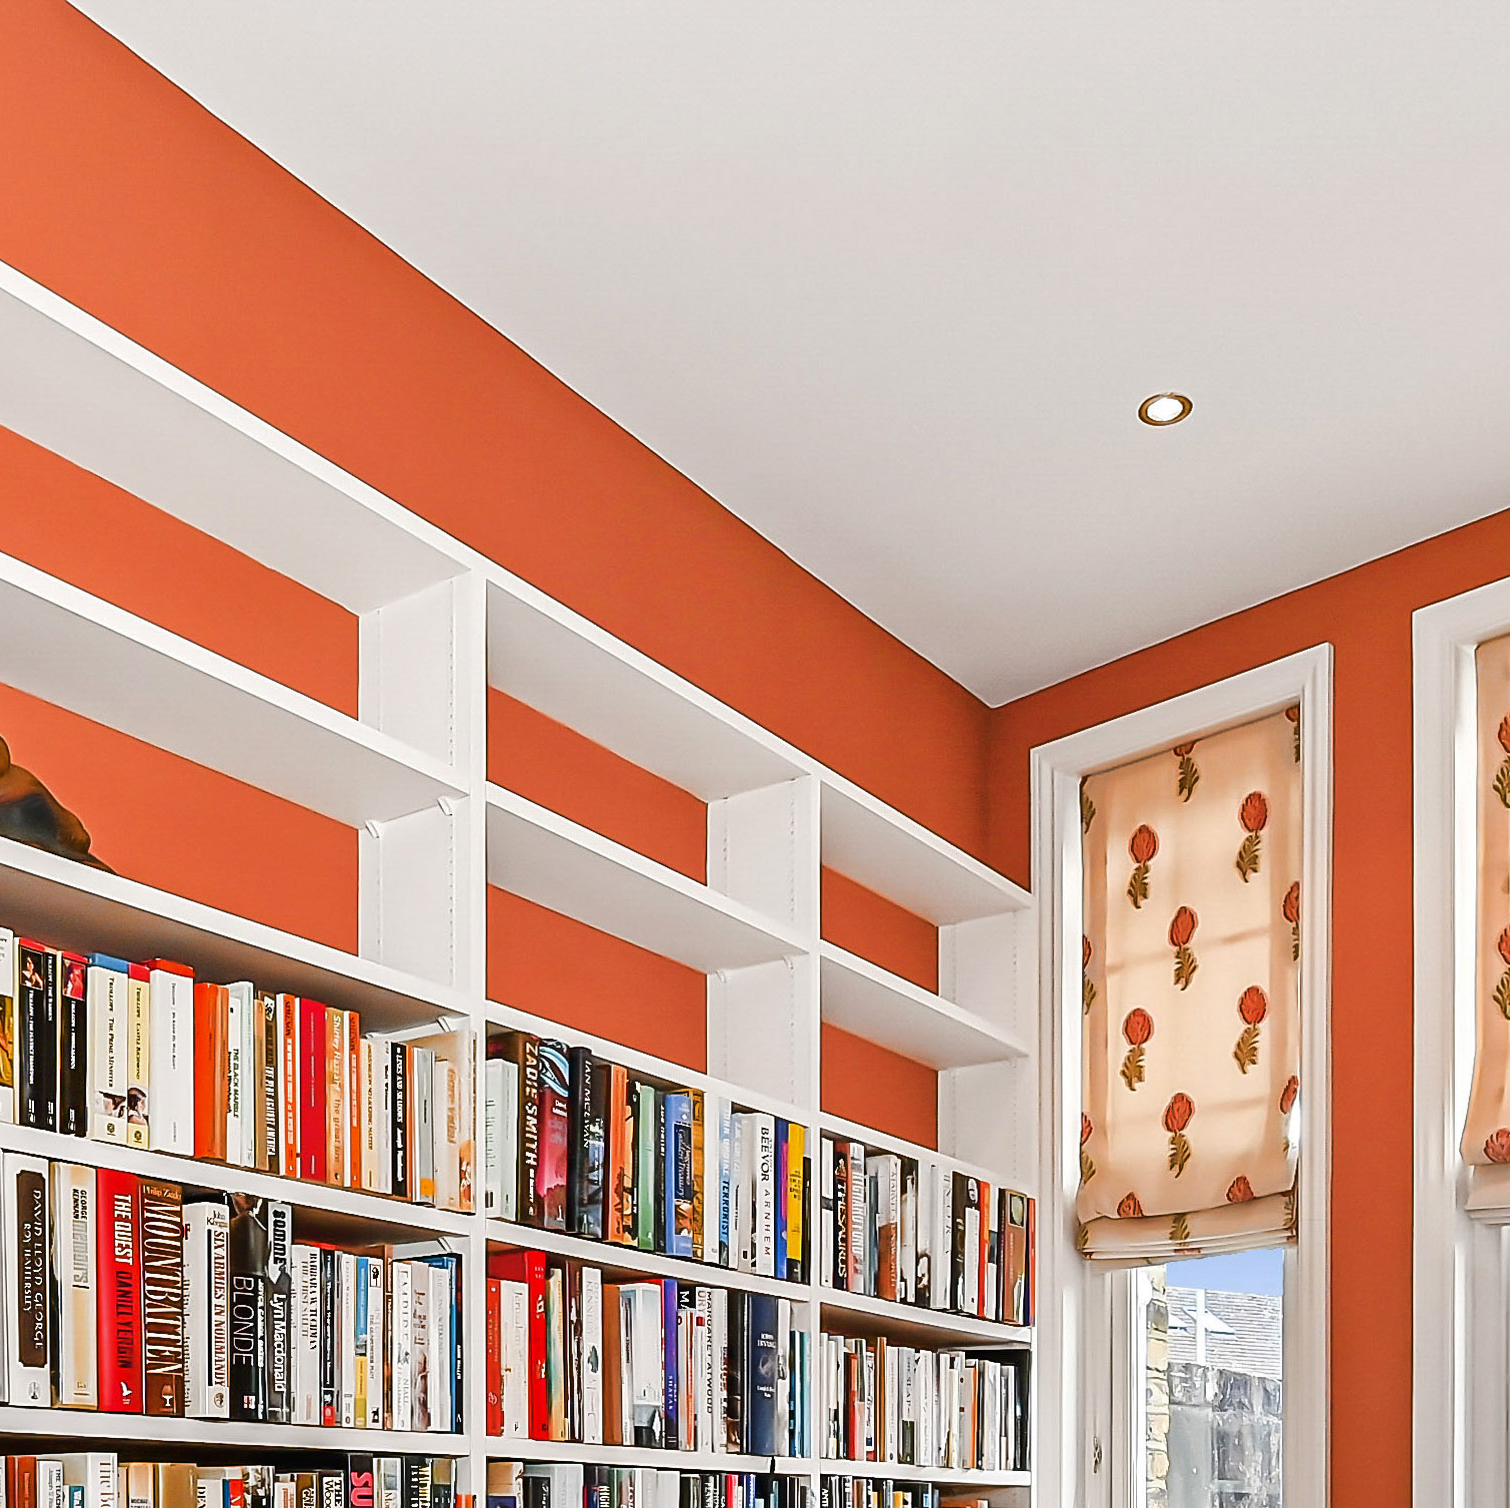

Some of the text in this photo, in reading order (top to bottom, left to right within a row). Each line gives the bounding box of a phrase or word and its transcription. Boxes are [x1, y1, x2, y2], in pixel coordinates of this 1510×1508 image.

[524, 1104, 537, 1164] SMITH
[114, 1194, 133, 1267] THE QUEST
[760, 1127, 771, 1256] BEEVOR ARNHEM
[144, 1199, 182, 1376] MOUNTBATTEN
[232, 1276, 253, 1368] BLONDE
[274, 1295, 286, 1393] Lyn Macdonald
[705, 1290, 714, 1415] MARGARET ATWOOD
